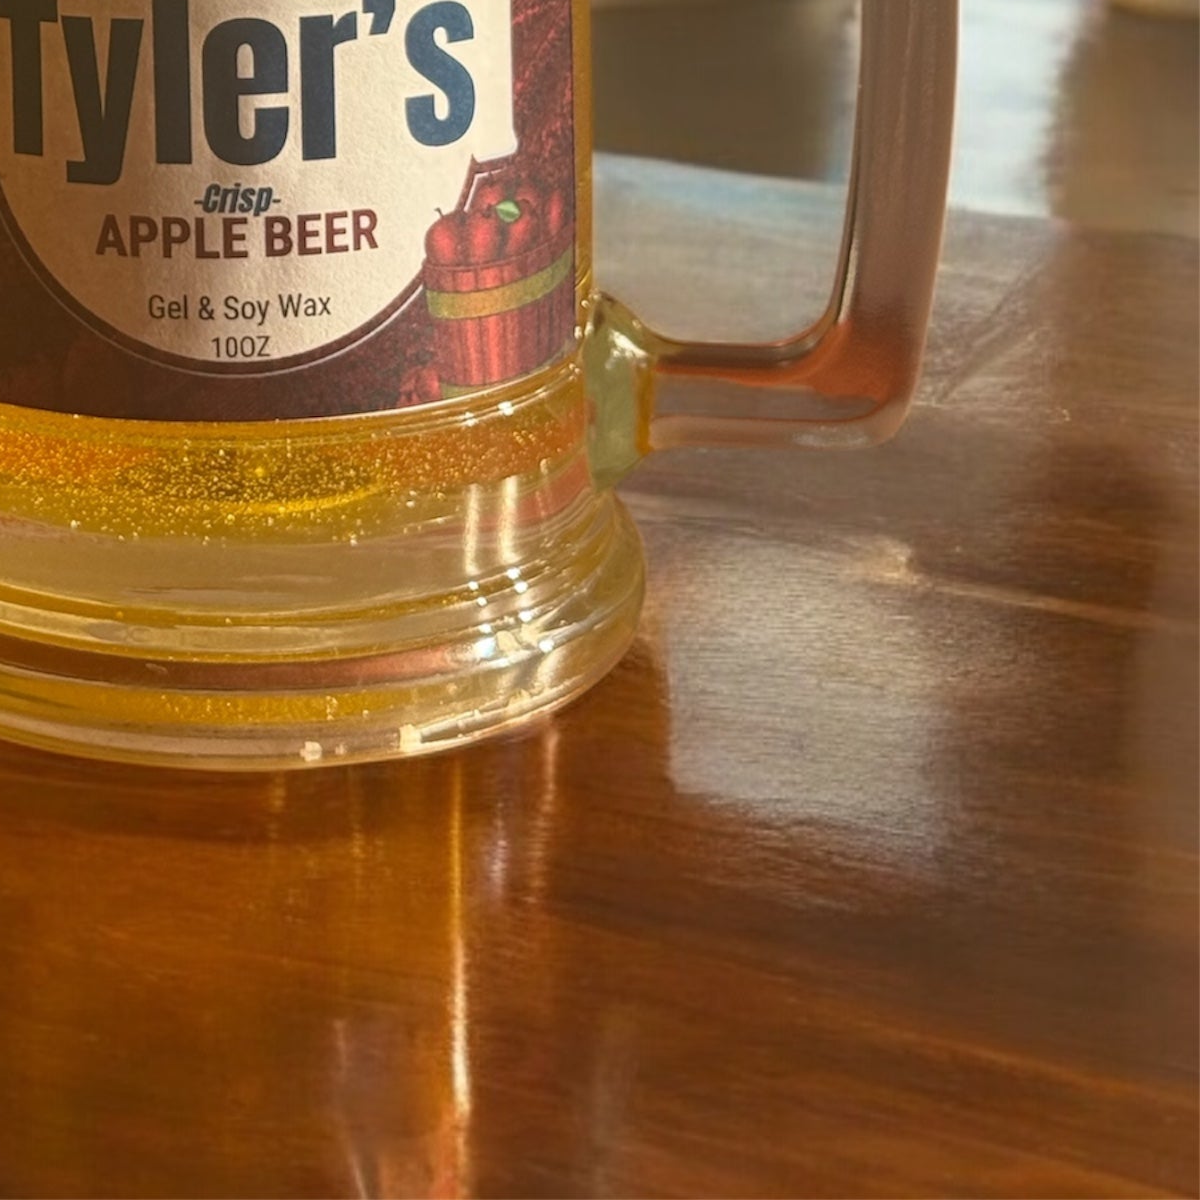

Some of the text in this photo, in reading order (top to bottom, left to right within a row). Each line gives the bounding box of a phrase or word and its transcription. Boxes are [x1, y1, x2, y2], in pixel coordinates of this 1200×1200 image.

[95, 208, 379, 259] APPLE BEER
[148, 293, 332, 326] Gel & Soy Wax
